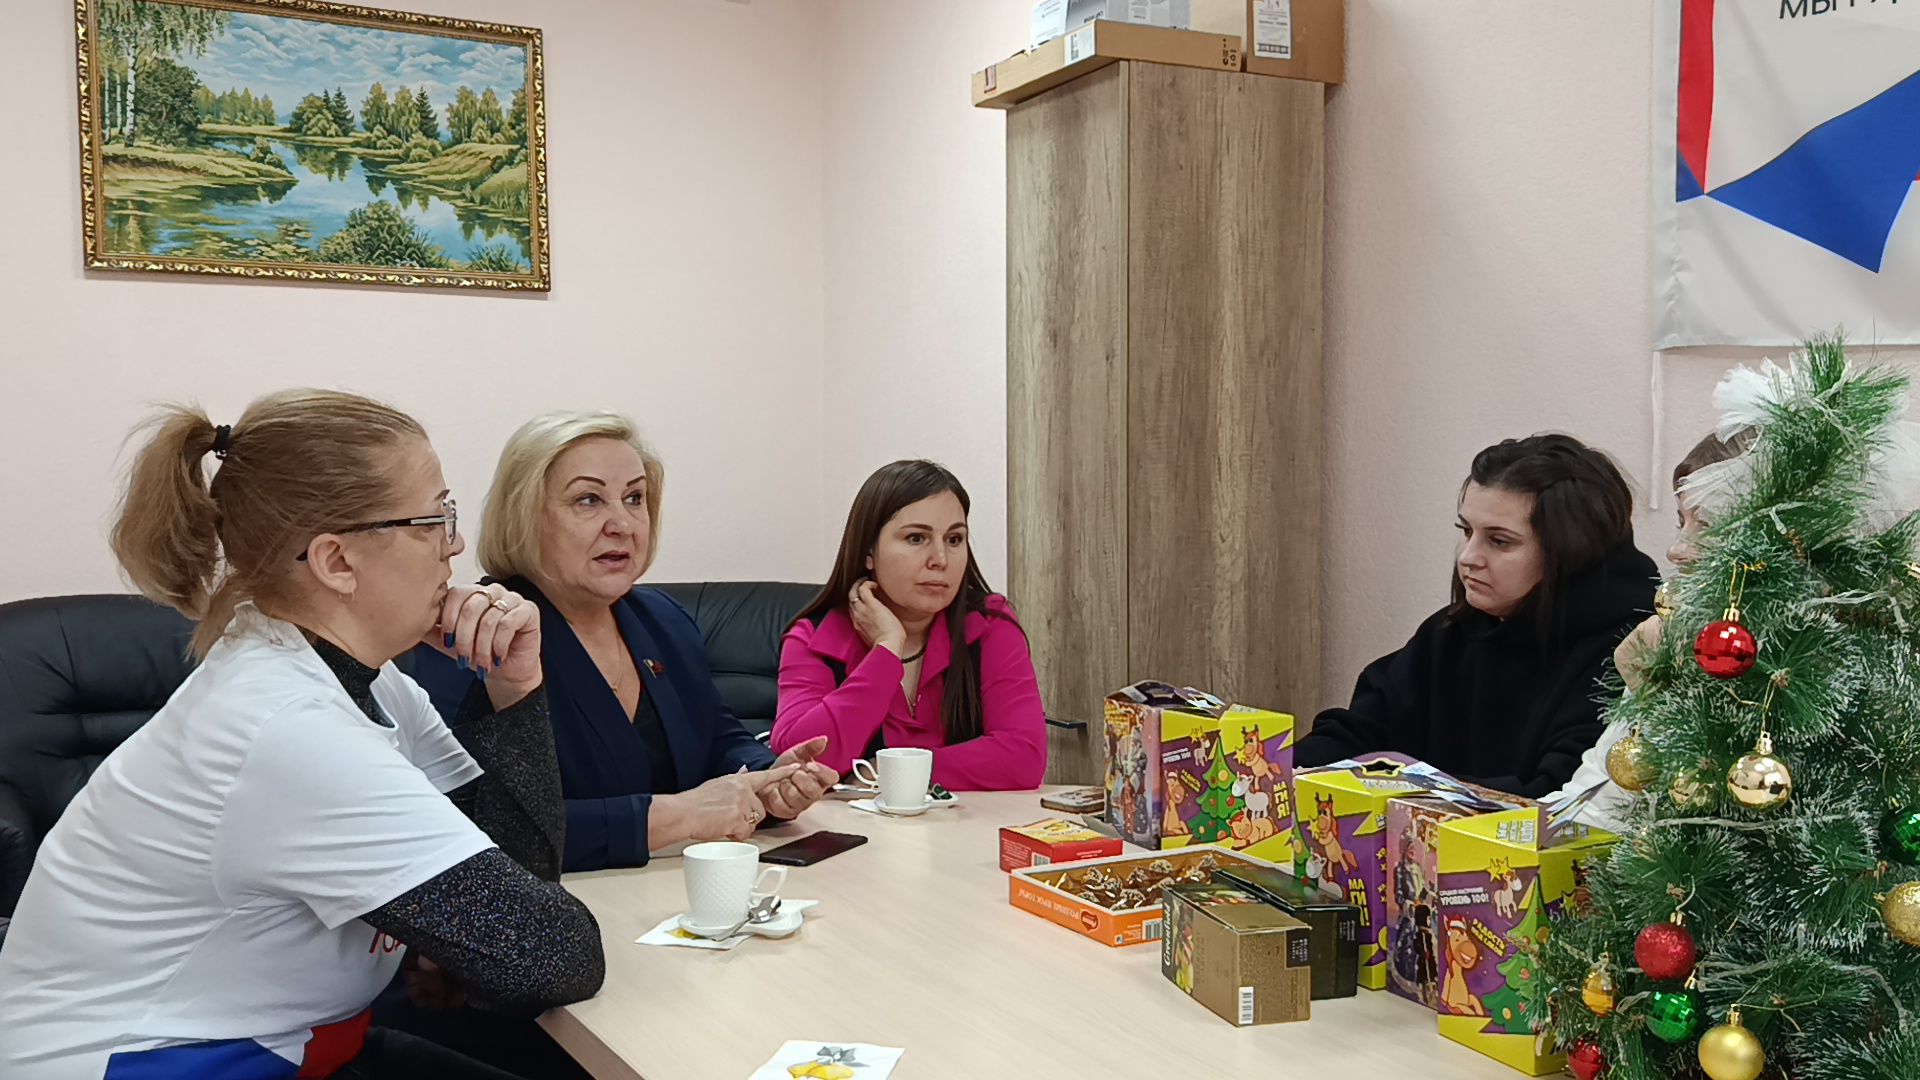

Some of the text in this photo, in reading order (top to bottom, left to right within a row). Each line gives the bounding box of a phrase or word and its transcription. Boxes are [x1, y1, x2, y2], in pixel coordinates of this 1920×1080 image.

[1277, 801, 1290, 819] Я!
[1348, 878, 1365, 890] МА
[1163, 902, 1171, 967] Greenfield
